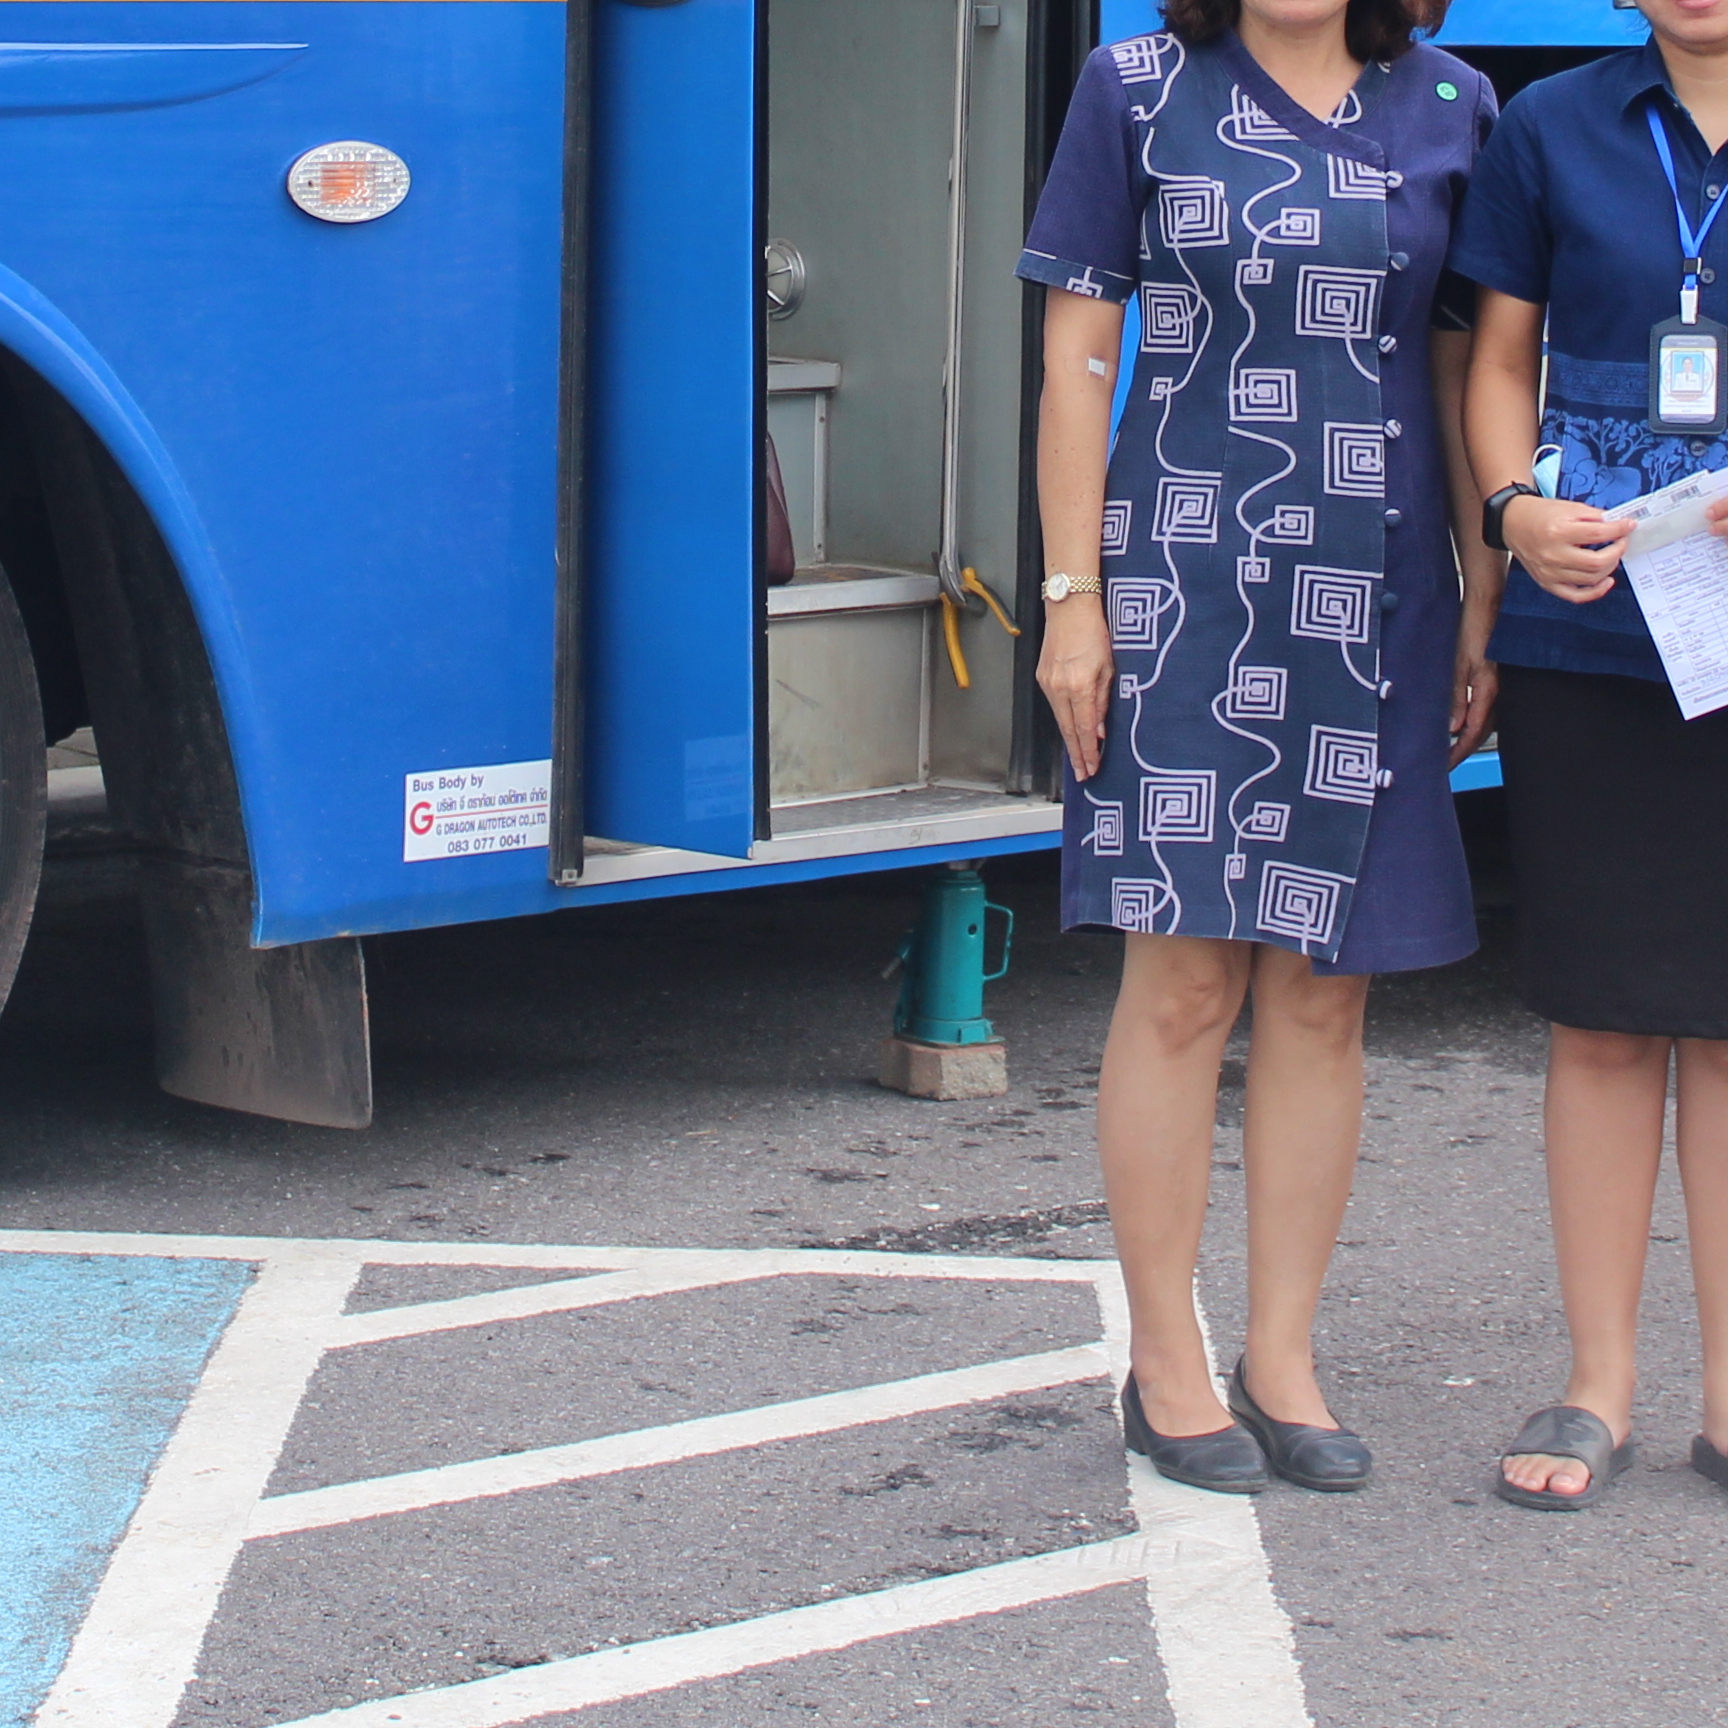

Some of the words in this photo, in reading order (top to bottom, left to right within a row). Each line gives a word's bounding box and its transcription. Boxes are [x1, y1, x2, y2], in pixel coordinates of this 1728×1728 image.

[412, 778, 434, 792] Bus
[438, 776, 467, 790] Body
[471, 773, 485, 789] by
[409, 801, 435, 836] G
[436, 824, 443, 836] G
[444, 819, 476, 835] DRAGON
[477, 814, 517, 831] AUTOTECH
[447, 839, 470, 854] 083
[473, 836, 495, 851] 077
[499, 833, 527, 848] 0041
